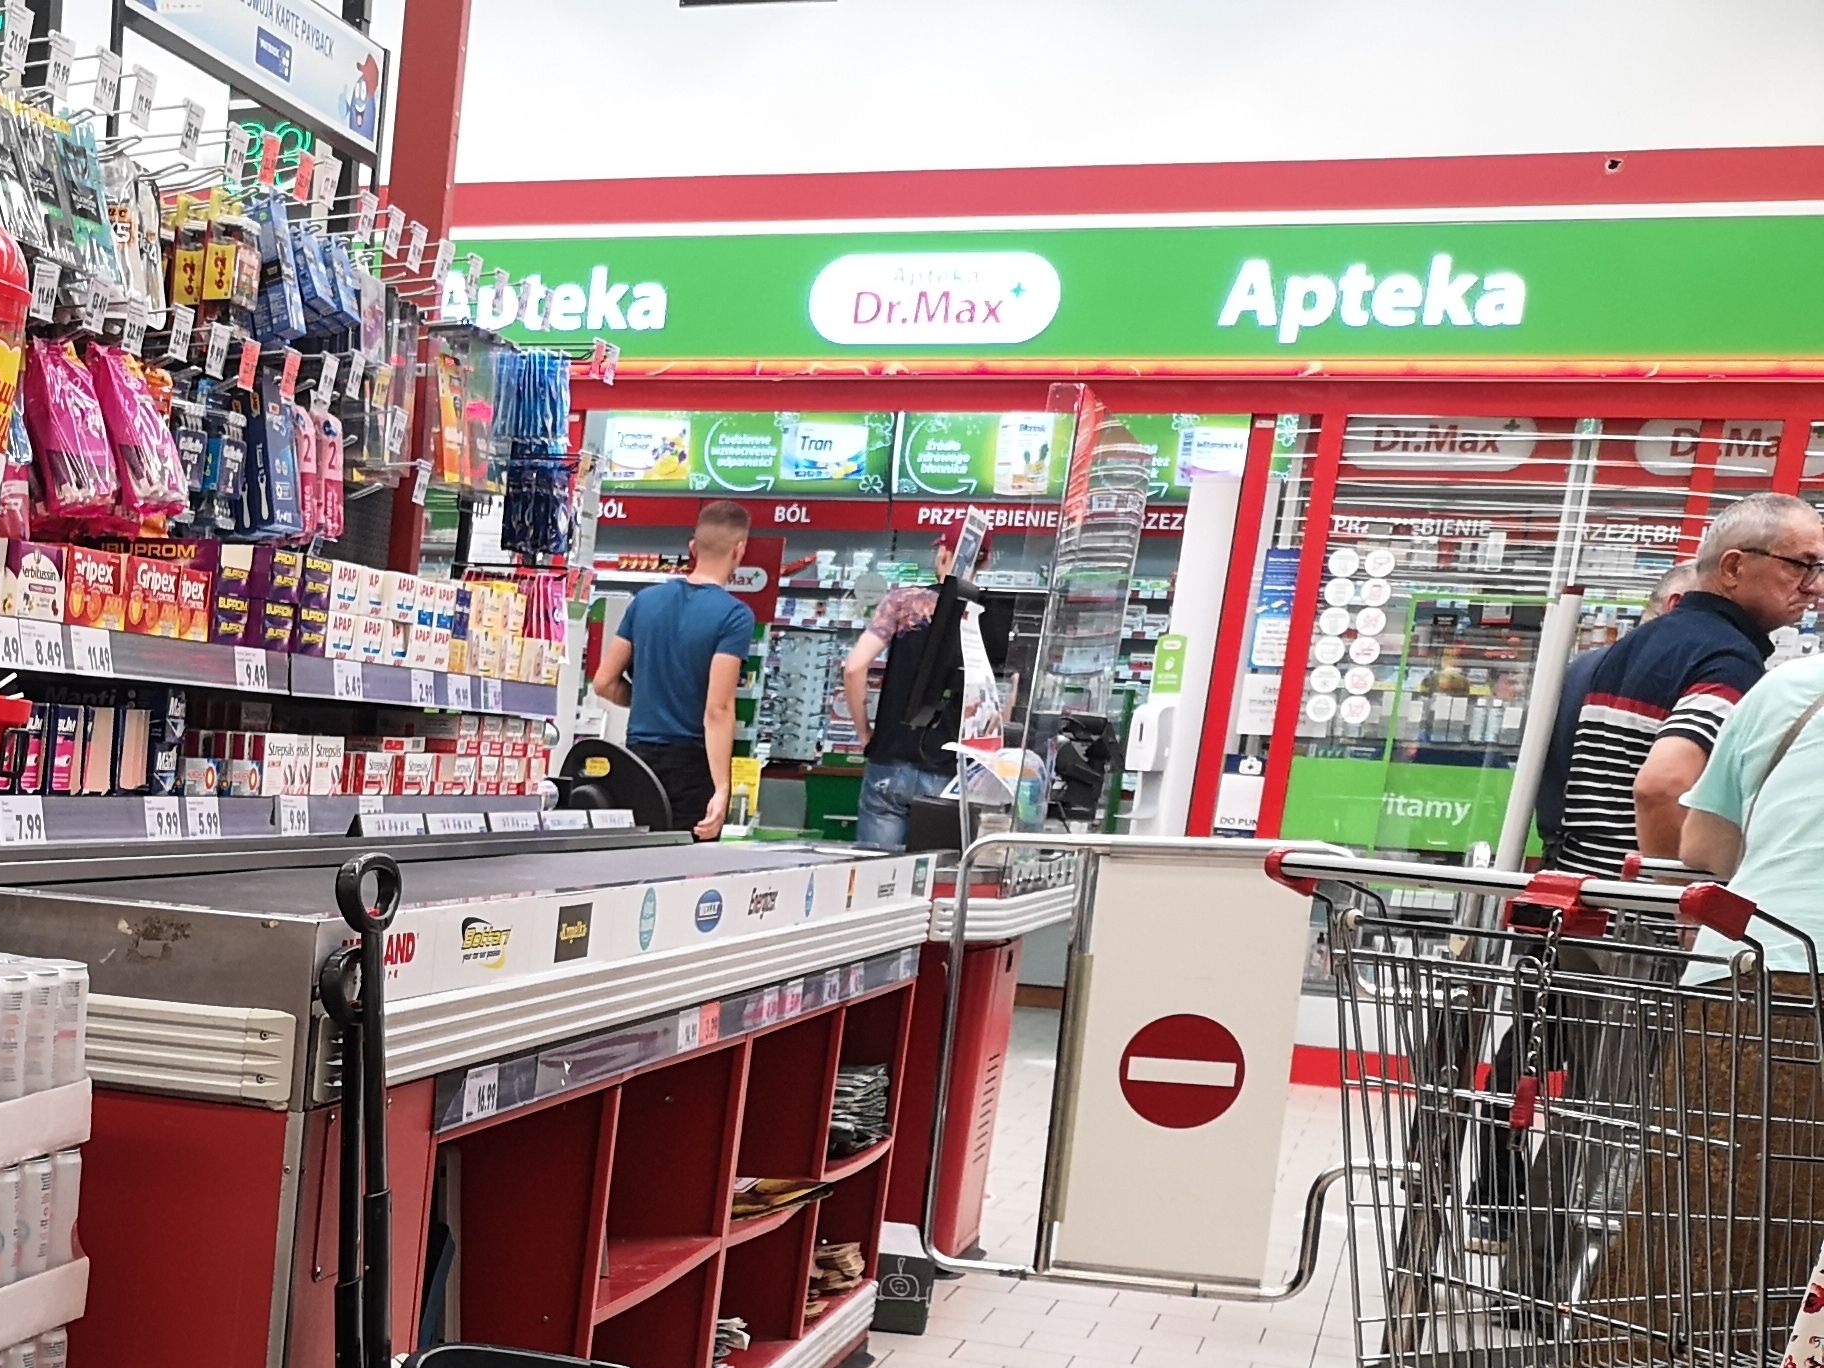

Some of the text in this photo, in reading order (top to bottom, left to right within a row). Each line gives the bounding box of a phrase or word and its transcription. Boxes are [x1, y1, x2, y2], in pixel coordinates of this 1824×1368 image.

[852, 290, 1004, 327] Dr.Max
[1217, 253, 1527, 344] Apteka
[800, 435, 833, 453] Tran
[1373, 424, 1503, 456] Dr.Max
[774, 505, 811, 524] BÓL
[917, 506, 1059, 529] PRZEĘBIENIE
[136, 562, 177, 593] Gripex
[338, 564, 358, 586] APAP
[398, 575, 416, 593] APAP
[333, 613, 353, 636] APAP
[363, 619, 382, 637] APAP
[35, 639, 63, 667] 8.49
[245, 663, 267, 688] 9.49
[15, 813, 43, 840] 7.99
[156, 811, 179, 836] 9.99
[198, 812, 219, 836] 5.99
[288, 806, 308, 829] 9.99
